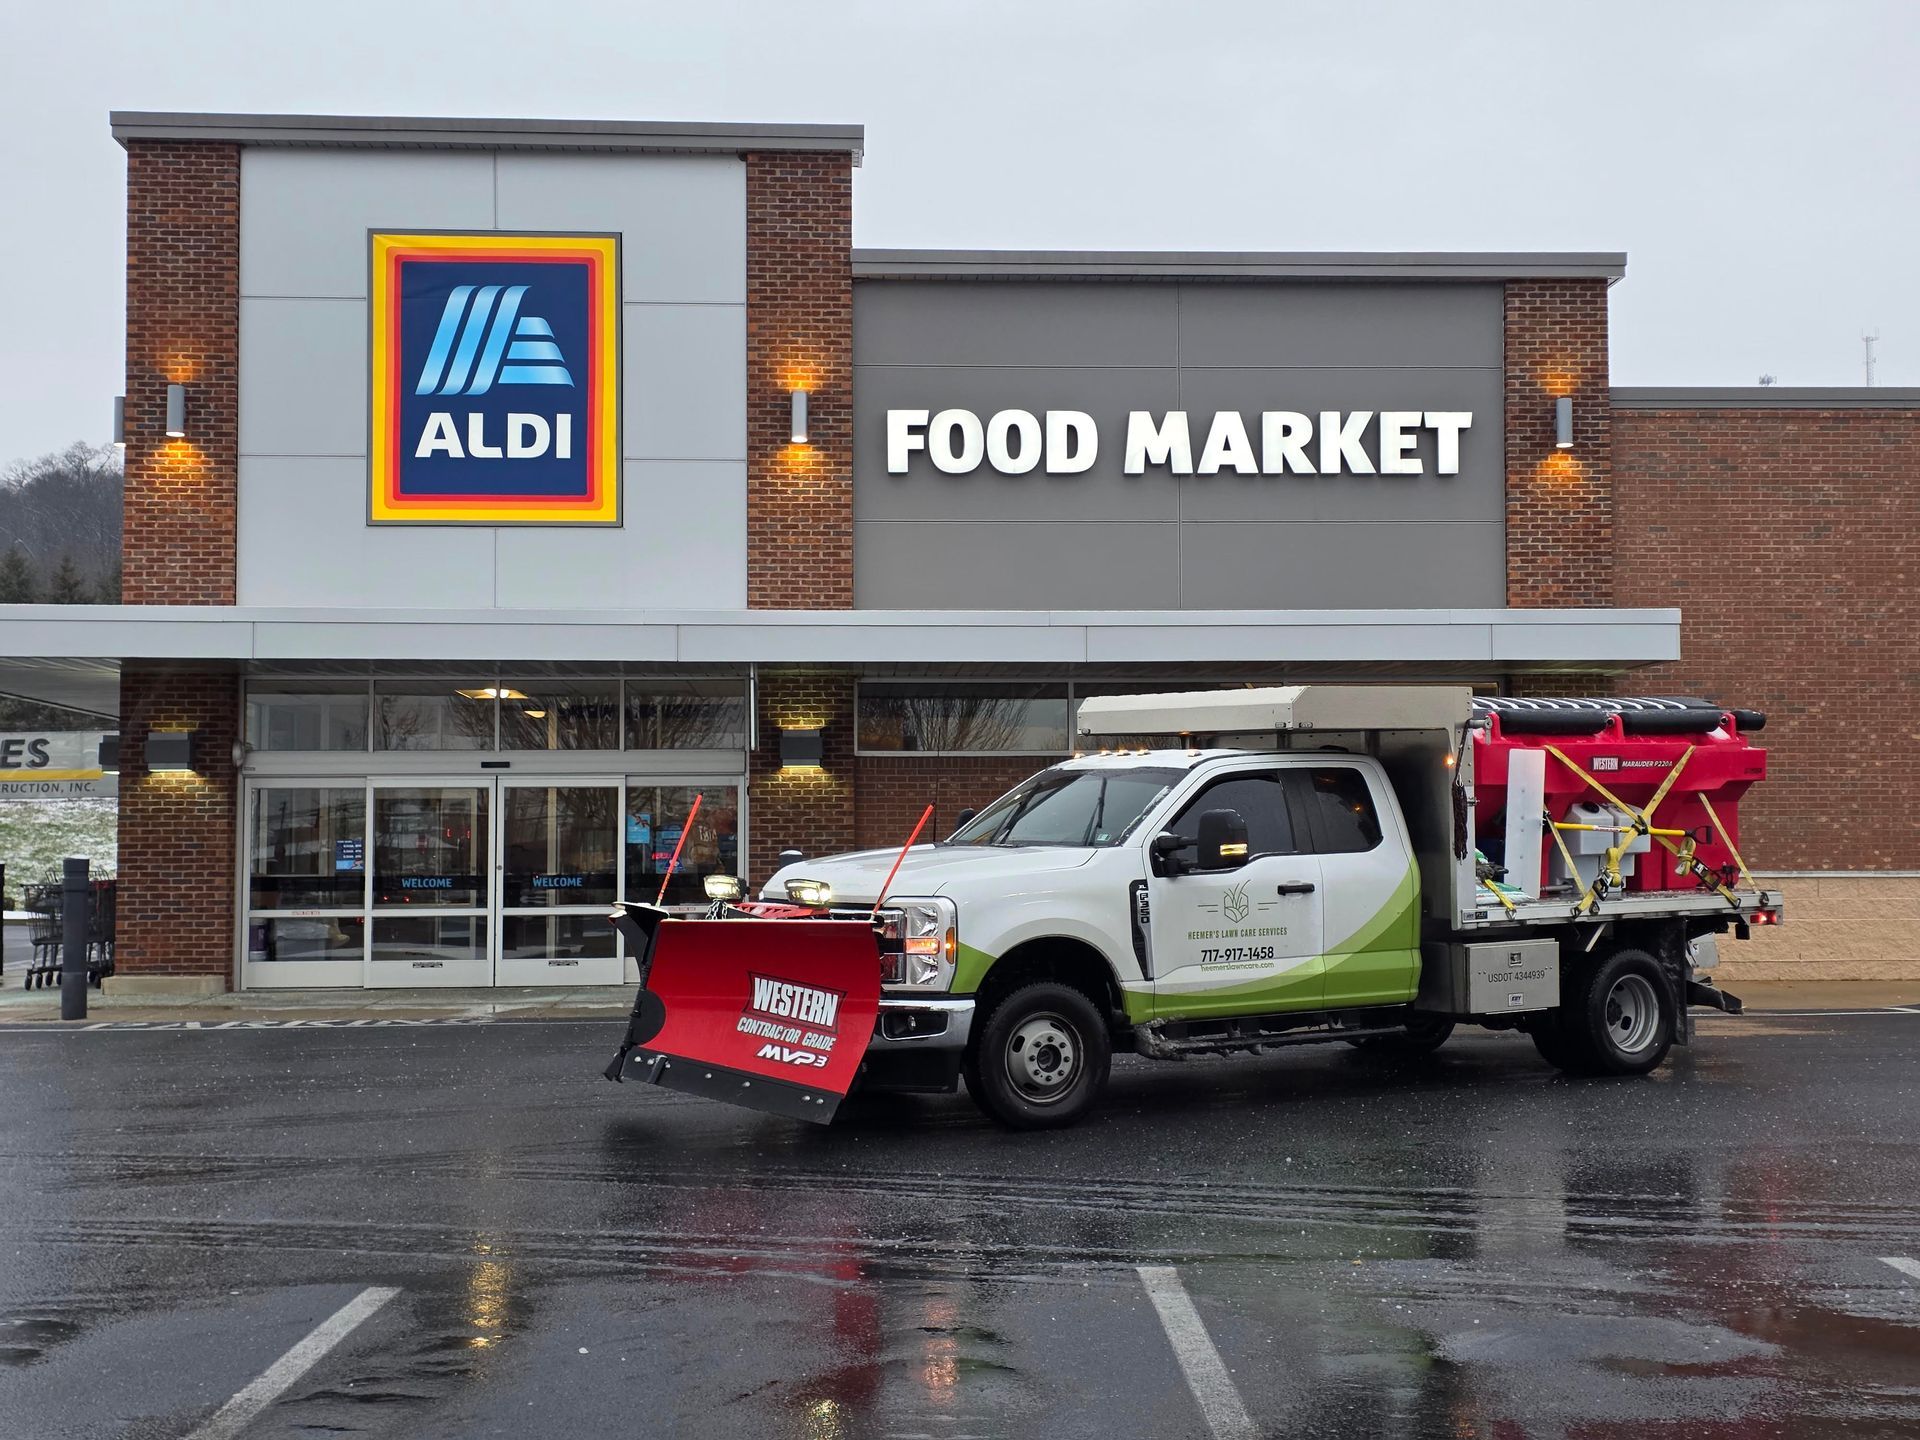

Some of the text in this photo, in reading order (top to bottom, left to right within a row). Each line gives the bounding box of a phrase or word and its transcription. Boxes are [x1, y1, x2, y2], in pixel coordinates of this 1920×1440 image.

[415, 412, 571, 459] ALDI
[887, 409, 1473, 474] FOOD MARKET
[0, 738, 50, 769] ES
[1593, 757, 1619, 770] WESTERN
[0, 782, 95, 793] RUCTION, INC.
[402, 878, 452, 888] WELCOME
[533, 877, 582, 887] WELCOME
[1188, 927, 1288, 940] HEEMER'S LAWN CARE SERVICES
[1201, 946, 1274, 962] 717-917-1458
[1201, 961, 1274, 972] heemerslawncare.com
[1488, 969, 1545, 983] USDOT 4344939
[753, 977, 838, 1027] WESTERN
[737, 1017, 836, 1051] CONTRACTOR GRADE
[757, 1044, 827, 1067] MVP3
